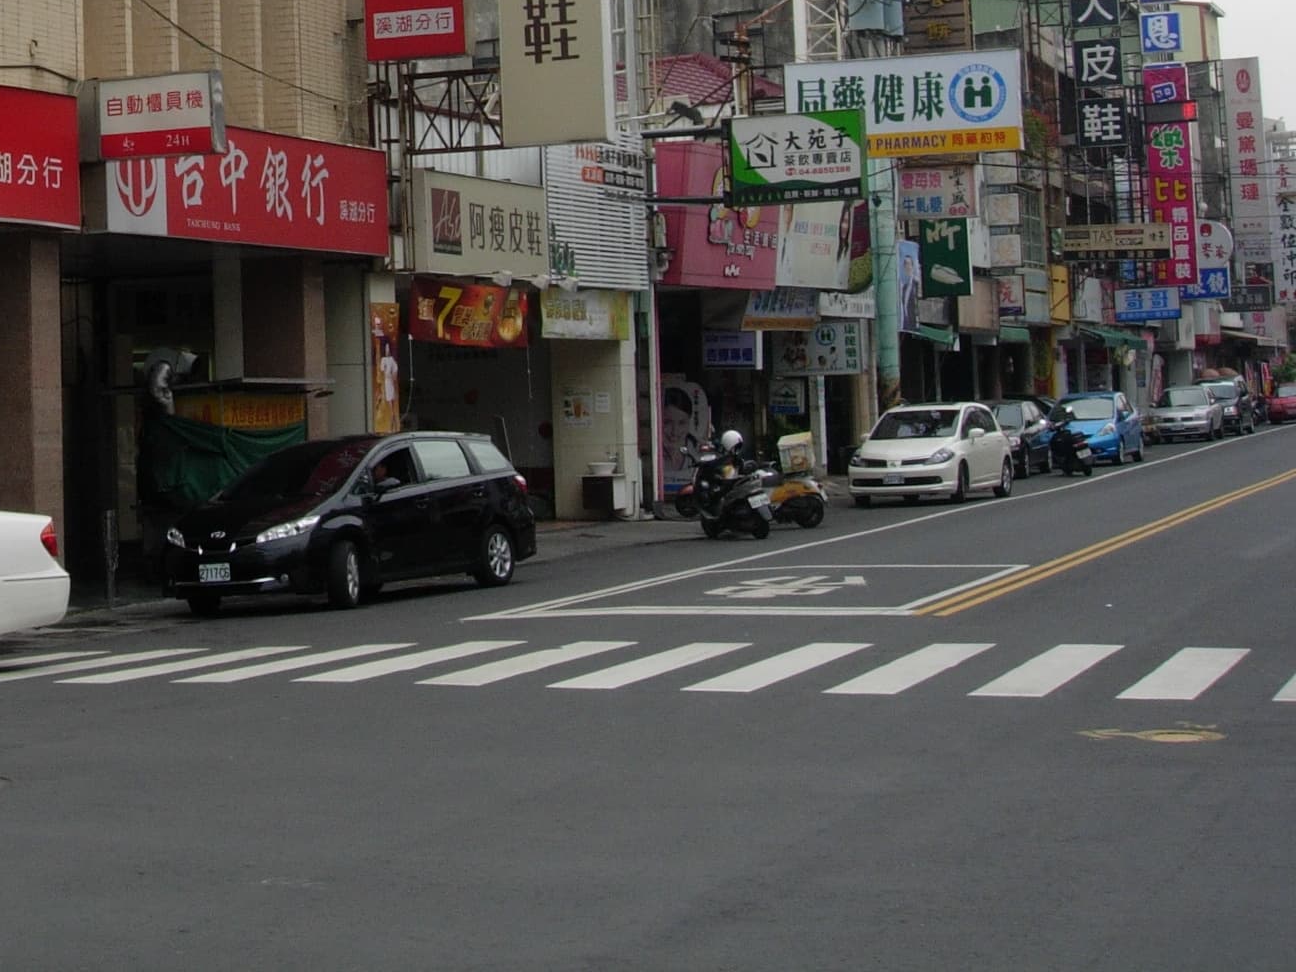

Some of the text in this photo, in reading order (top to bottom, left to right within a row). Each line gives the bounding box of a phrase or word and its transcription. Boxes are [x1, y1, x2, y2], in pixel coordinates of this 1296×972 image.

[375, 11, 454, 37] 溪湖分行
[106, 89, 204, 117] 自動櫃員機
[165, 133, 190, 148] 24H
[784, 127, 852, 151] 大苑子
[875, 134, 947, 151] PHARMACY
[174, 139, 329, 226] 台中銀行
[469, 202, 542, 257] 阿瘦皮鞋
